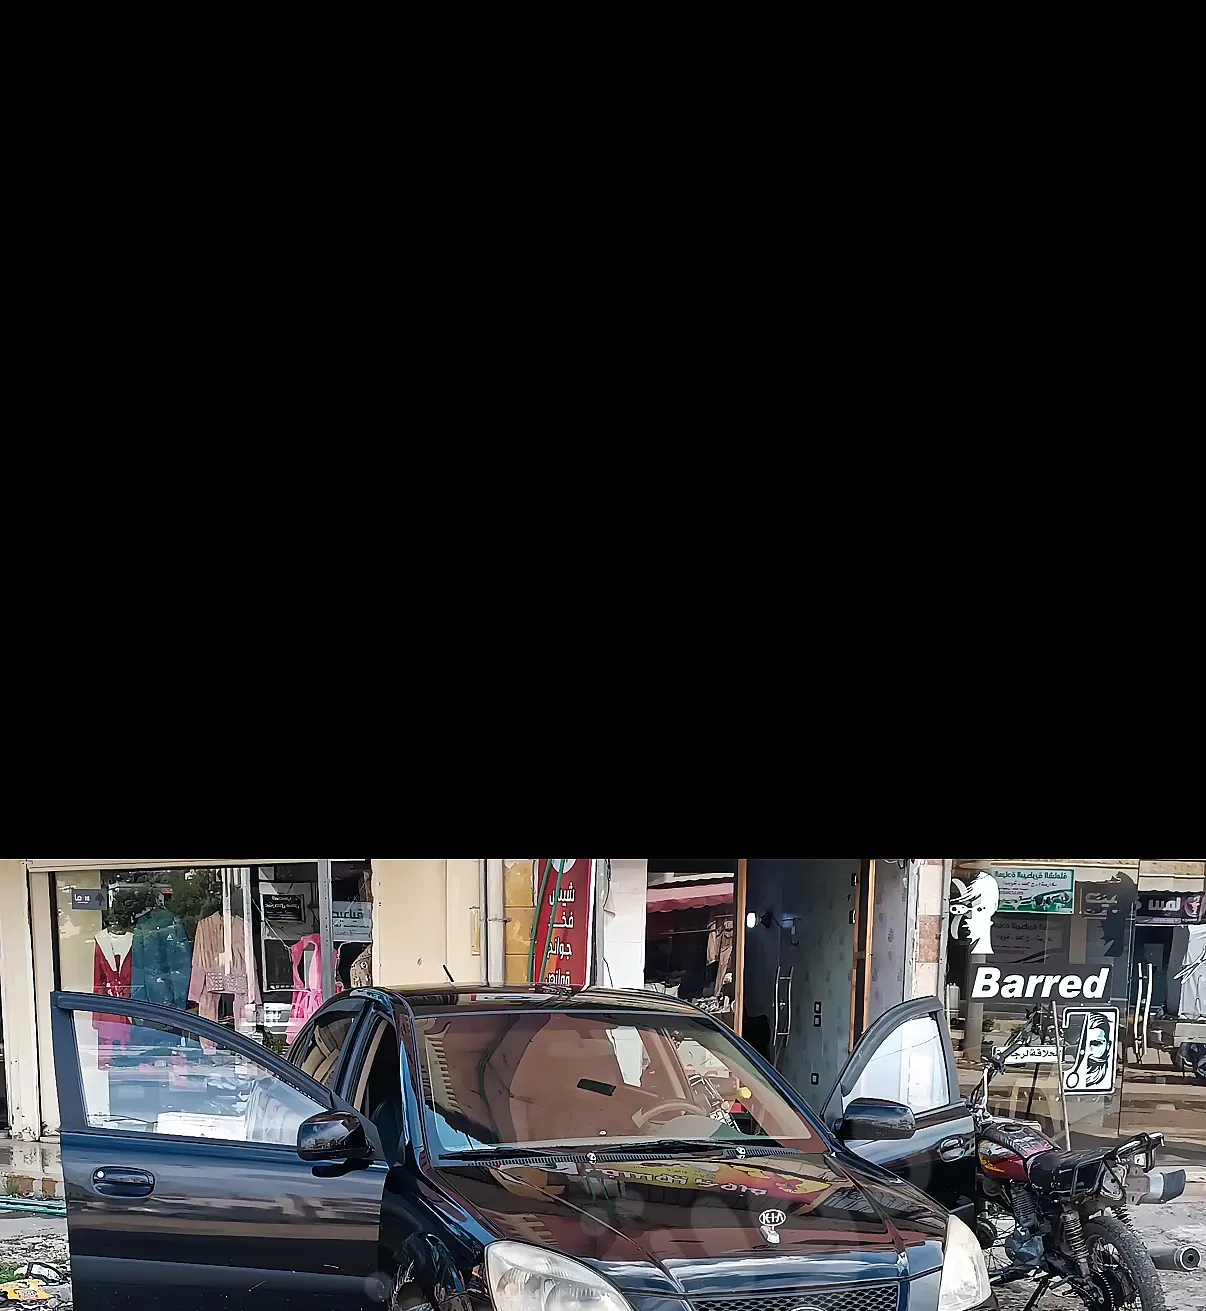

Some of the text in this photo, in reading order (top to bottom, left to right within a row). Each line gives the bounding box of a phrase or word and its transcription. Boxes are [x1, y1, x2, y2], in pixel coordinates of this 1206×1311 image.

[547, 936, 573, 960] جوانح
[971, 966, 1110, 999] Barred
[760, 1210, 786, 1225] KIA
